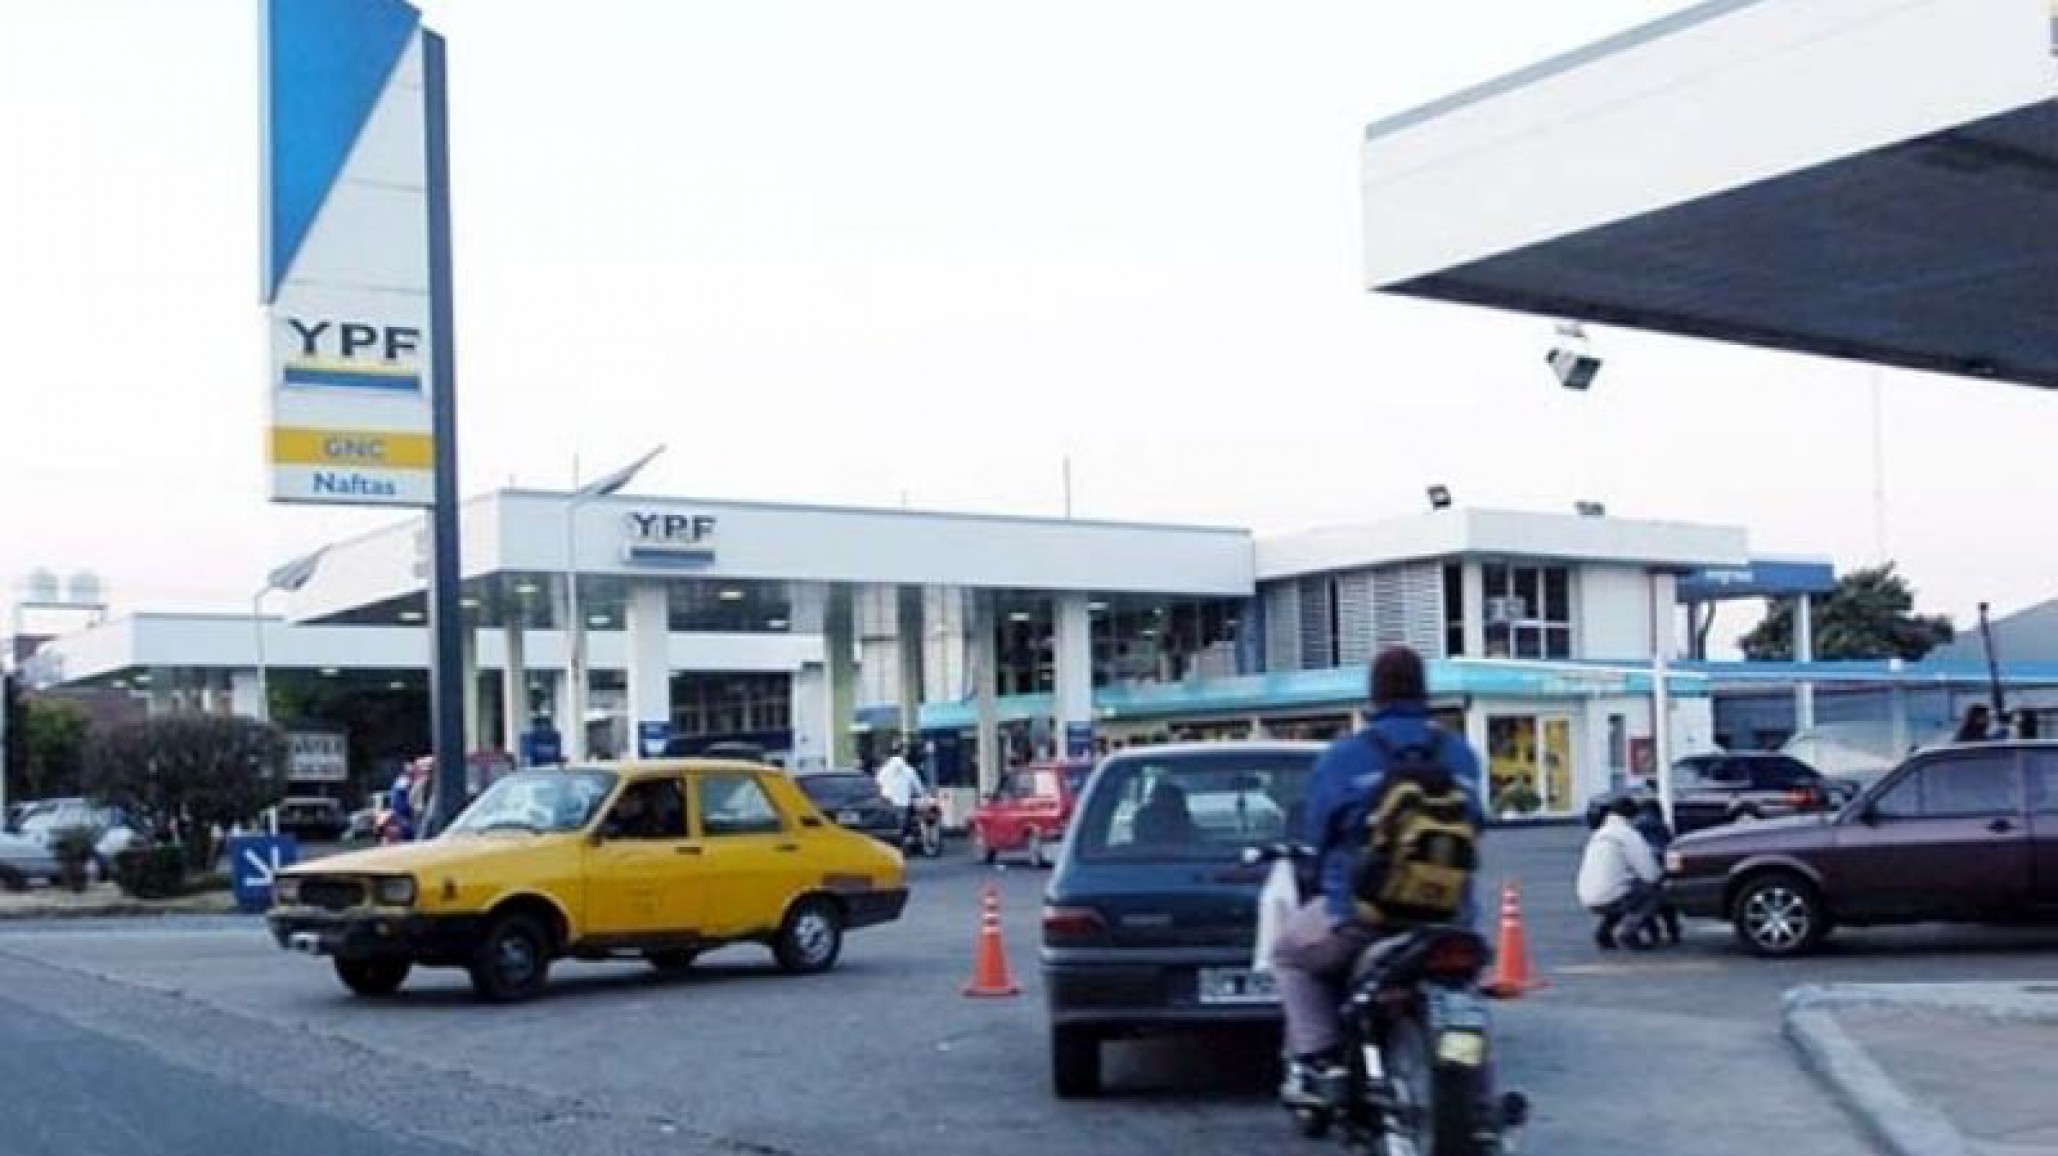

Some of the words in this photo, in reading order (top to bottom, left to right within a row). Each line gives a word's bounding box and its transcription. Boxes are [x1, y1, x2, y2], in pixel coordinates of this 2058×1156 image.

[287, 318, 420, 358] YPF
[323, 437, 385, 458] GNC
[312, 472, 397, 495] Naftas
[630, 511, 717, 541] YPF
